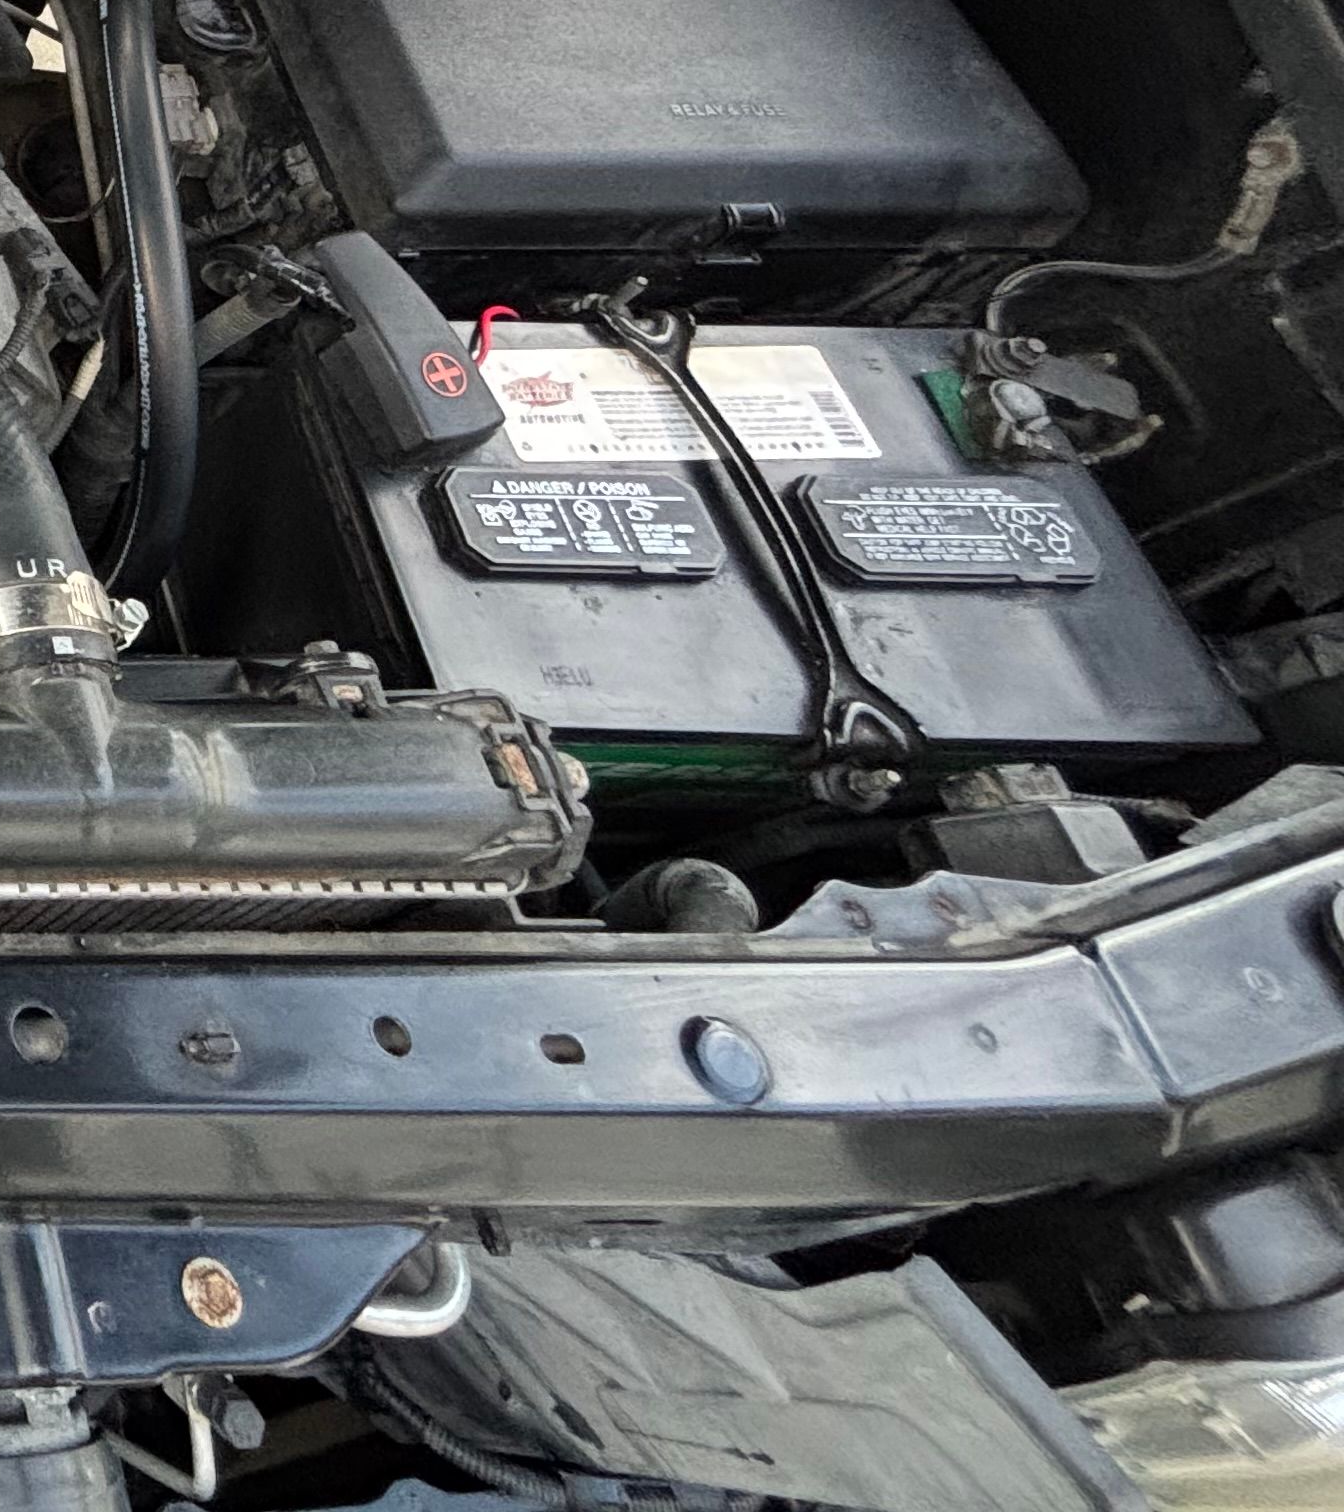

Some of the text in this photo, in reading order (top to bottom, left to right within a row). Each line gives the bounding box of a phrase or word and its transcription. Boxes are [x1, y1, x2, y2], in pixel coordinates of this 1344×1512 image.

[669, 104, 725, 117] RELAY
[743, 104, 788, 117] FUSE
[519, 414, 586, 425] AUTOMOTIVE
[507, 481, 575, 495] DANGER
[590, 482, 651, 496] POISON
